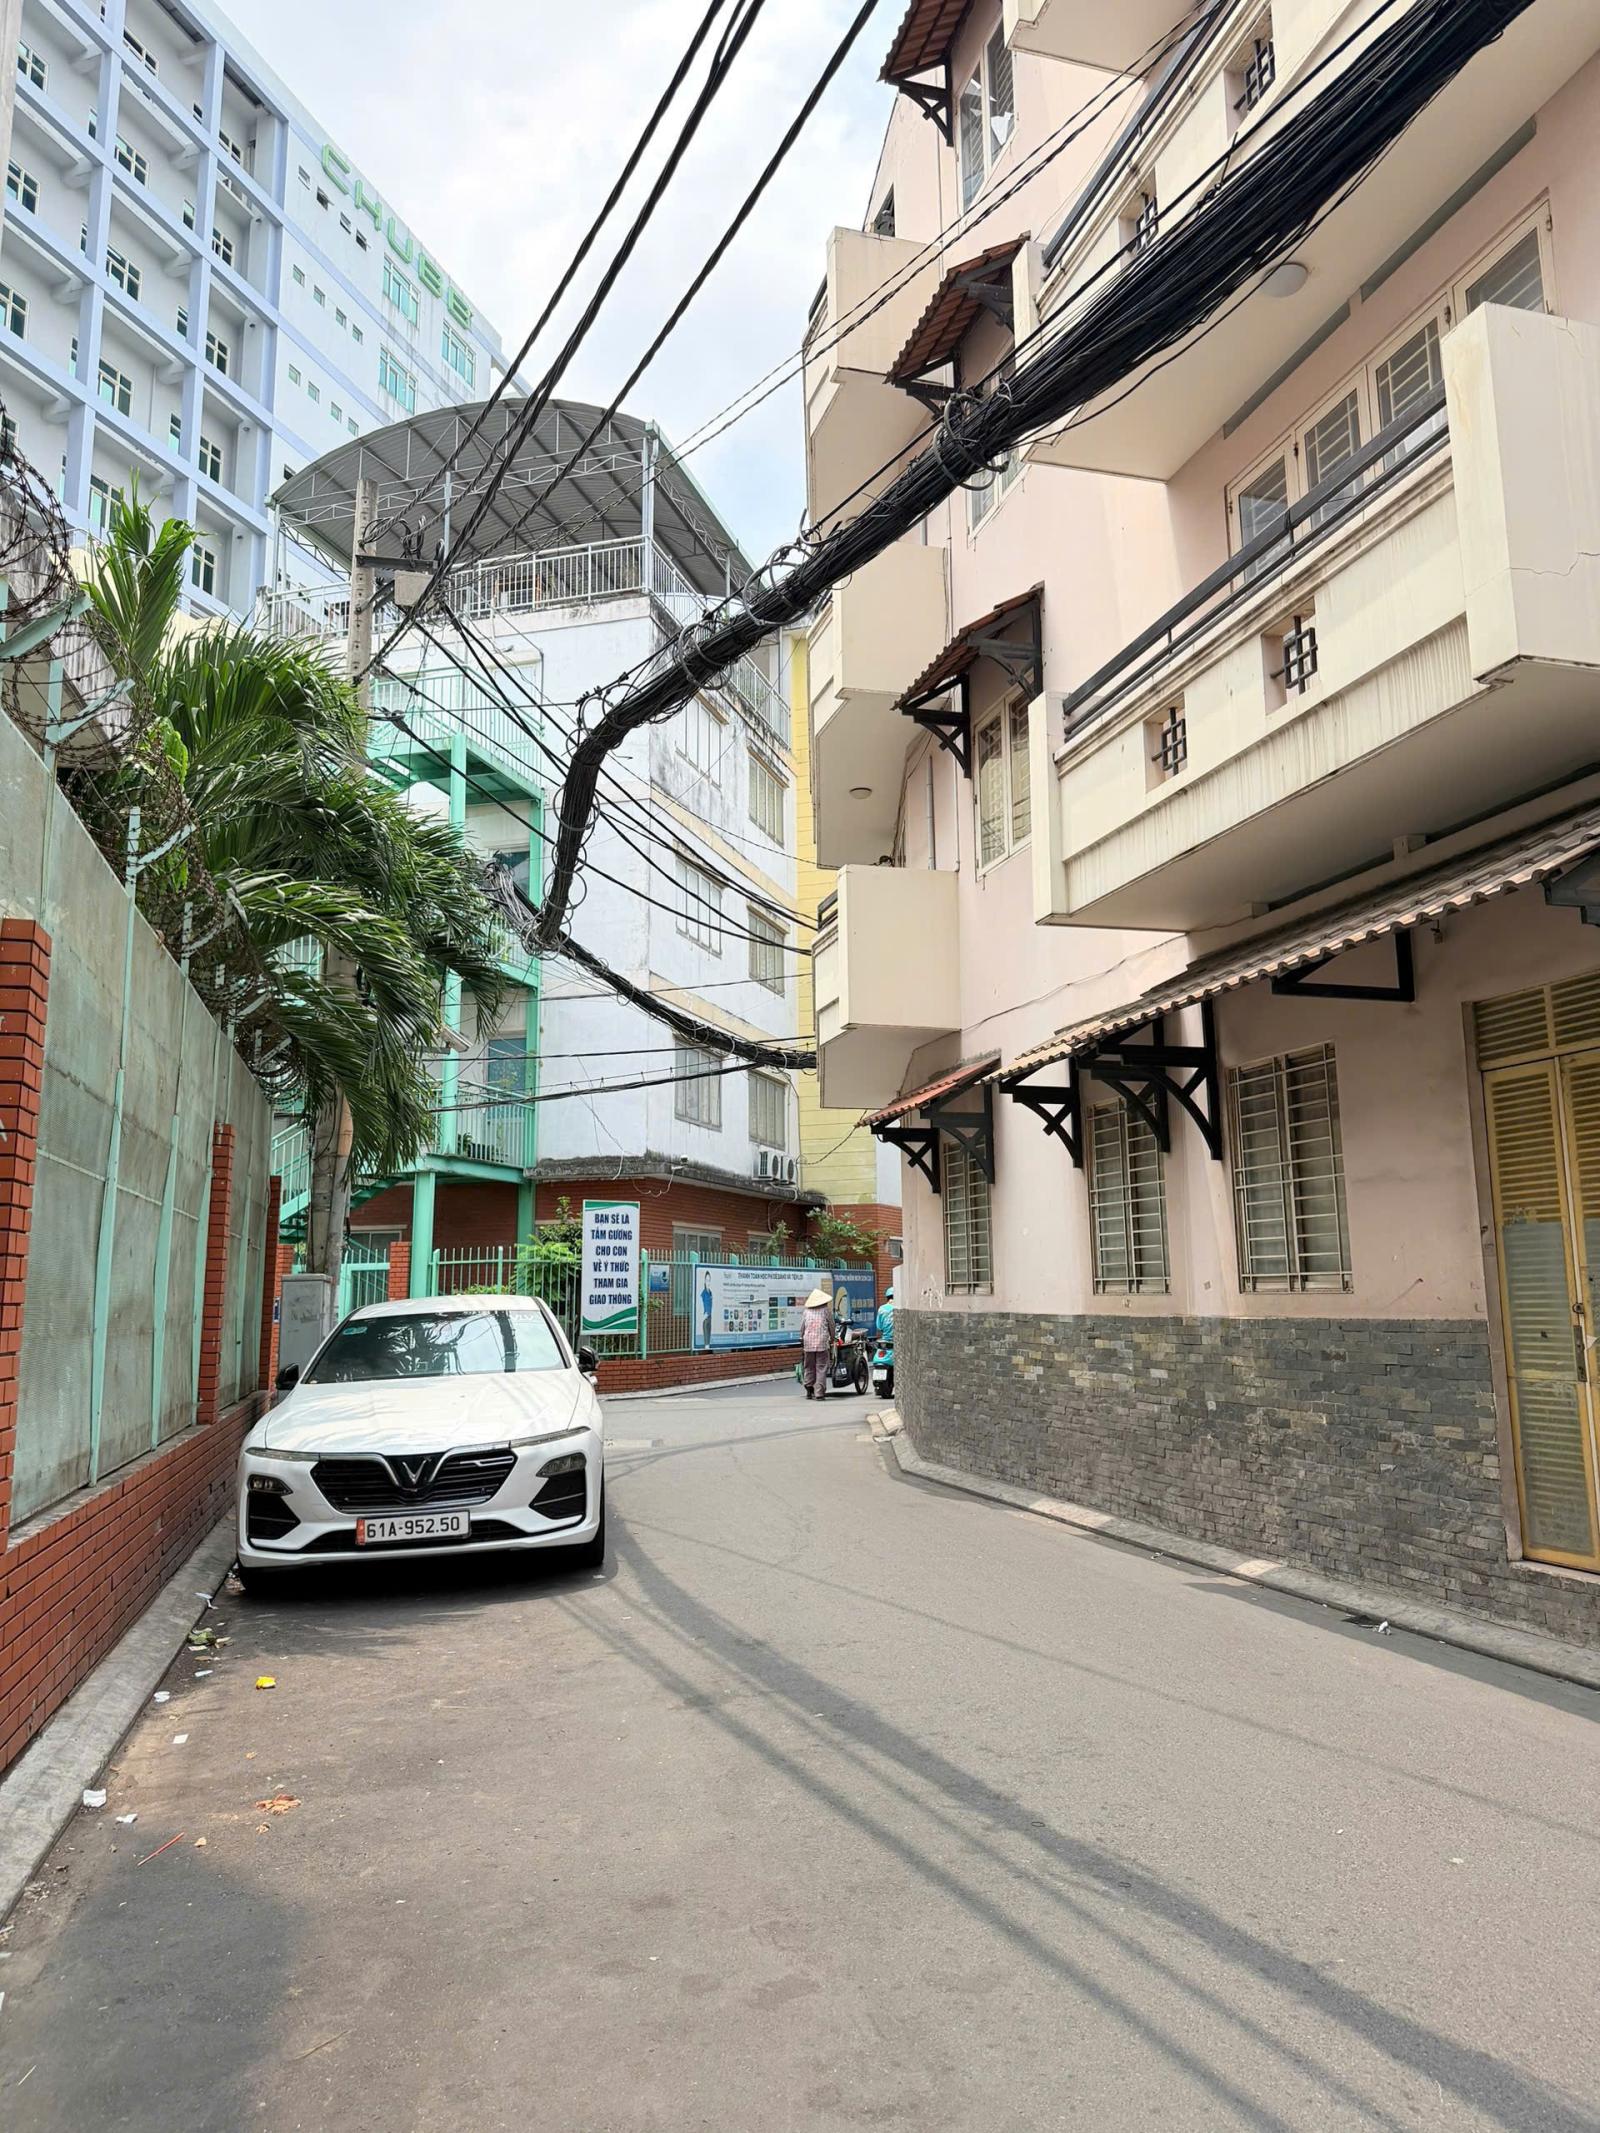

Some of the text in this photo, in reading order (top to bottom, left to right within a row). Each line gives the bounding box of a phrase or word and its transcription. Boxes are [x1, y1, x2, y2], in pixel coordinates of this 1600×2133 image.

[594, 1212, 630, 1226] BẠN SẼ LÀ
[591, 1226, 633, 1241] TẤM GƯƠNG
[595, 1245, 628, 1256] CHO CON
[593, 1259, 630, 1272] VỀ Ý THỨC
[593, 1278, 628, 1289] THAM GIA
[589, 1292, 632, 1305] GIAO THÔNG
[366, 1516, 460, 1539] 61A-952.50
